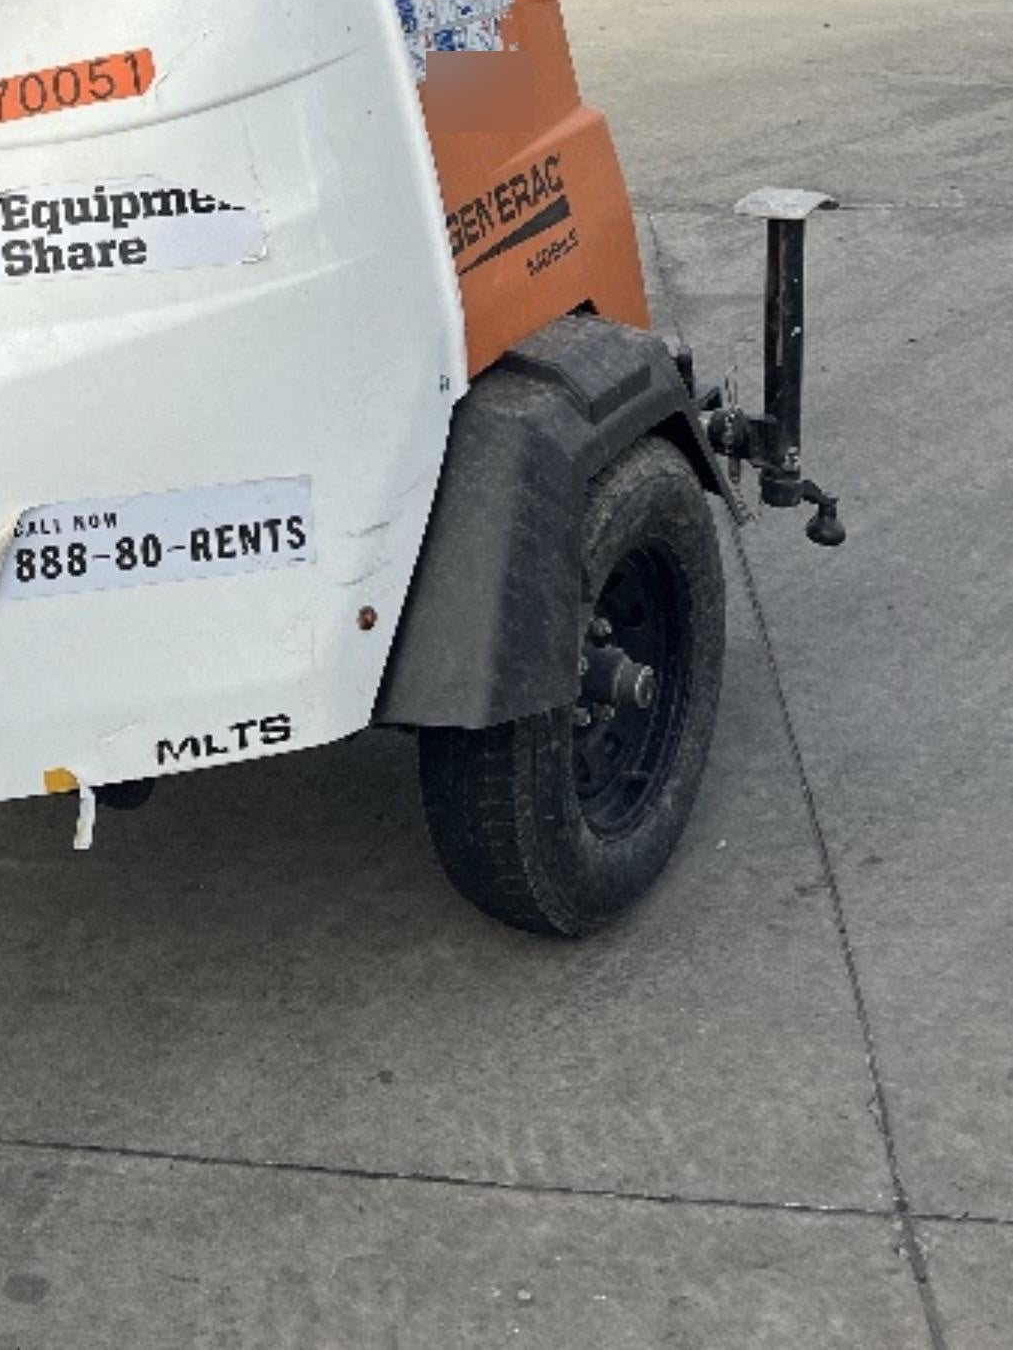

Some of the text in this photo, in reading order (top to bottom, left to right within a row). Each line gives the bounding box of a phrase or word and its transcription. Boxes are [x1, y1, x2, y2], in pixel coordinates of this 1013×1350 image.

[0, 186, 246, 236] Equipme
[0, 237, 148, 278] Share
[73, 511, 118, 532] NOW
[15, 515, 307, 583] 888-80-RENTS
[156, 713, 292, 766] MLTS
